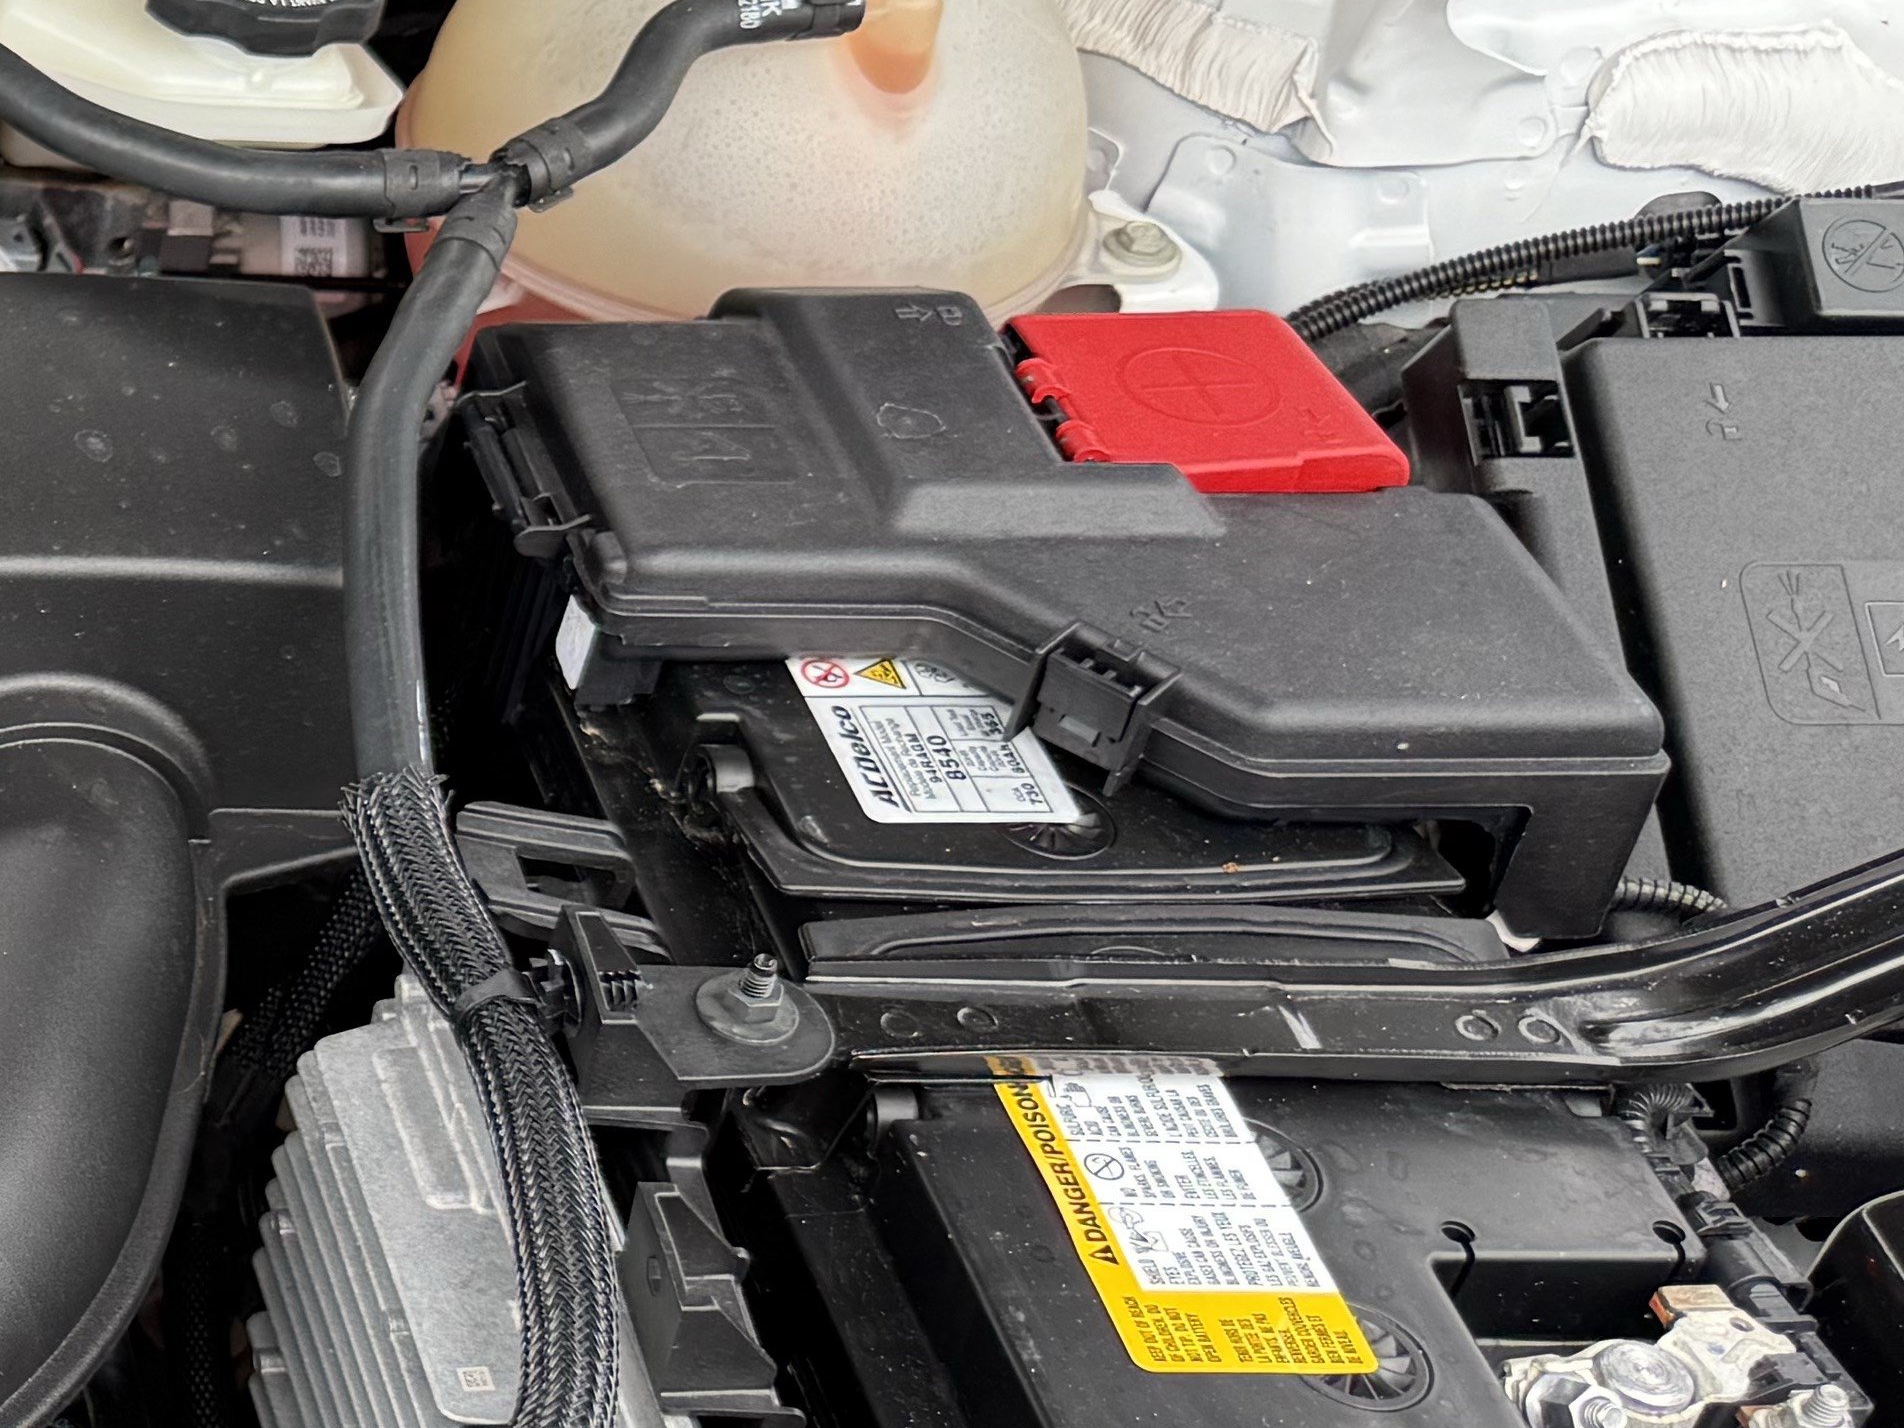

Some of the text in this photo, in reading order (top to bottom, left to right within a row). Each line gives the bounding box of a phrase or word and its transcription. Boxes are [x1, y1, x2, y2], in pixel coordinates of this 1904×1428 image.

[979, 712, 1003, 733] 365
[831, 705, 902, 808] ACDelco
[922, 735, 968, 779] 8540
[1018, 782, 1044, 804] 730
[1011, 1084, 1107, 1242] DANGER/POISON
[1221, 1233, 1241, 1244] LES
[1162, 1266, 1185, 1284] EYES
